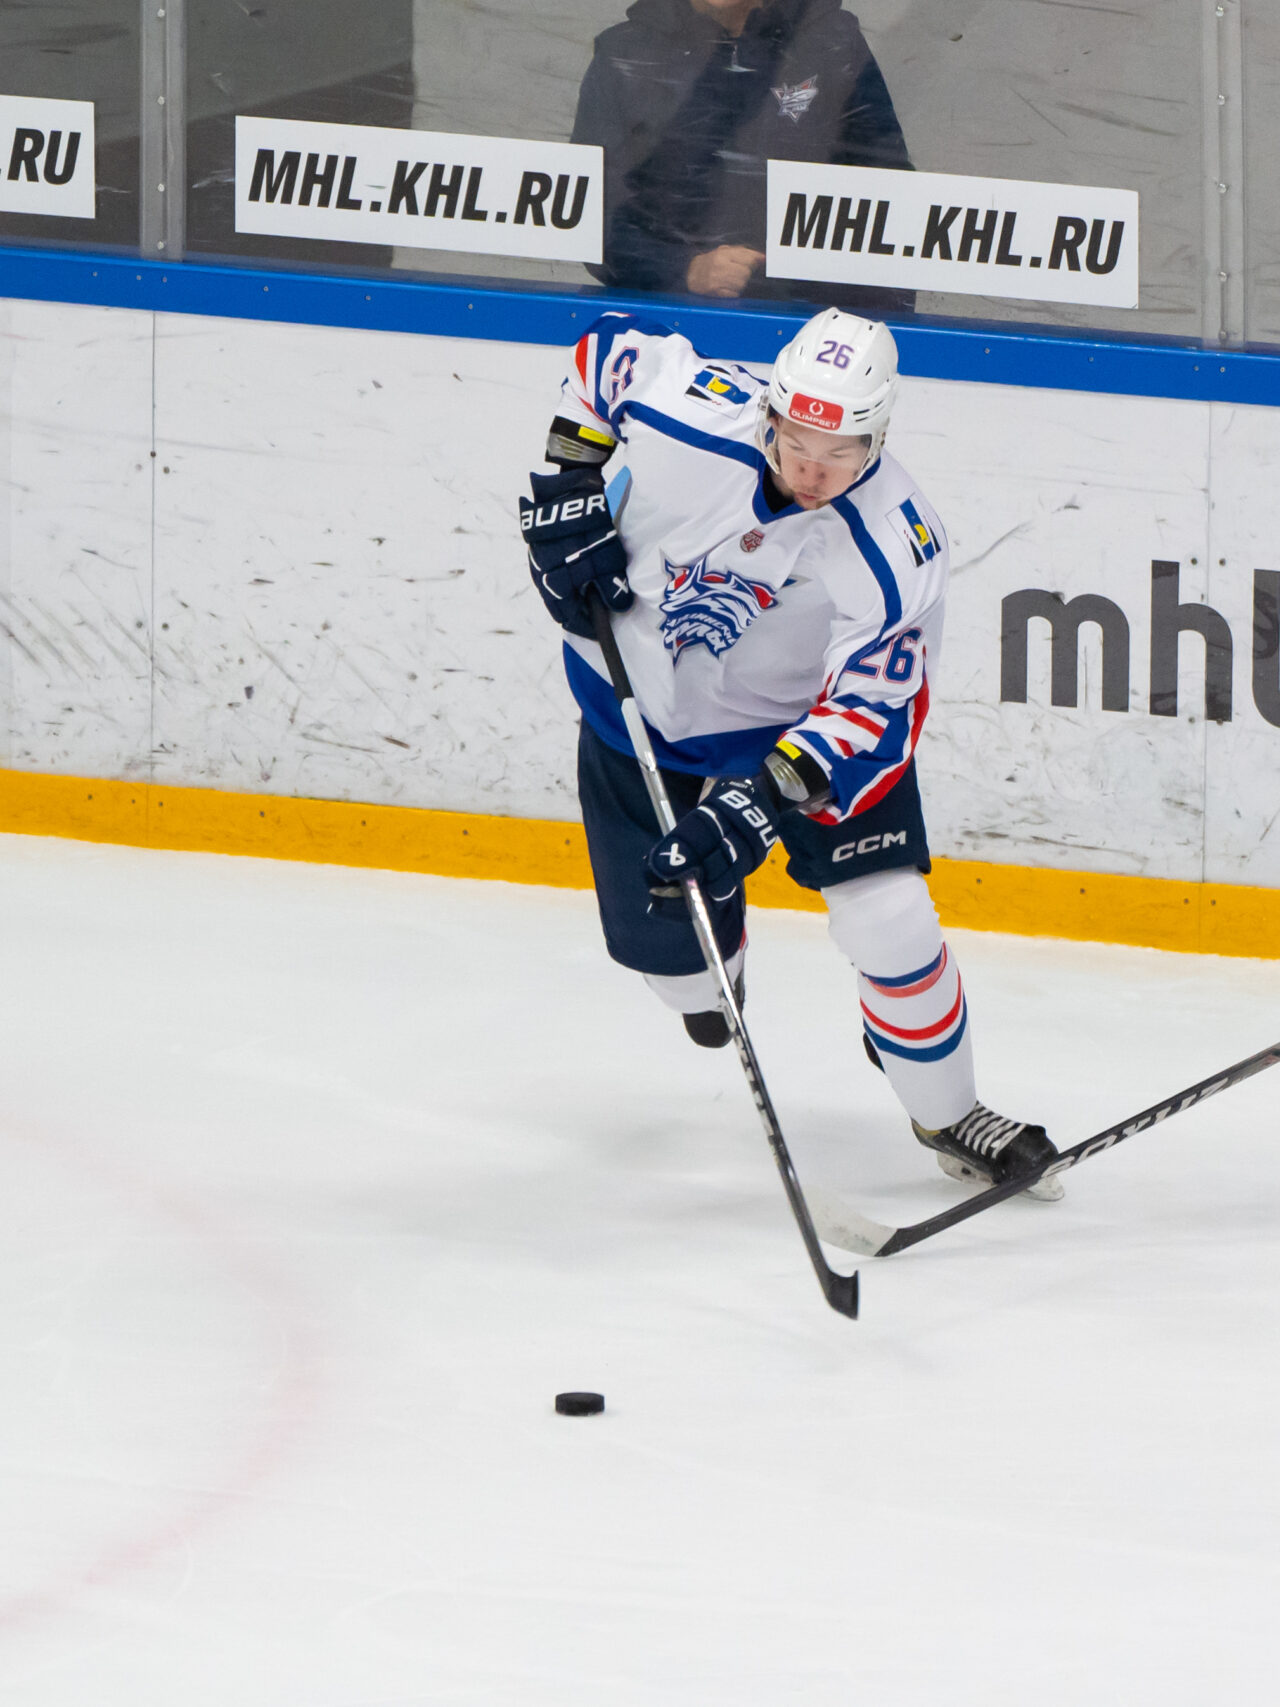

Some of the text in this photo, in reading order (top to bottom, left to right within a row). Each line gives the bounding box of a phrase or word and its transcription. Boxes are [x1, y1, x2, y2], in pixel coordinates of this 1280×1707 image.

[0, 127, 82, 186] RU
[247, 148, 590, 230] MHL.KHL.RU
[779, 192, 1125, 275] MHL.KHL.RU
[815, 339, 855, 370] 26
[790, 409, 838, 430] OLIMPBET
[520, 493, 607, 531] AUER
[831, 829, 908, 864] CCM
